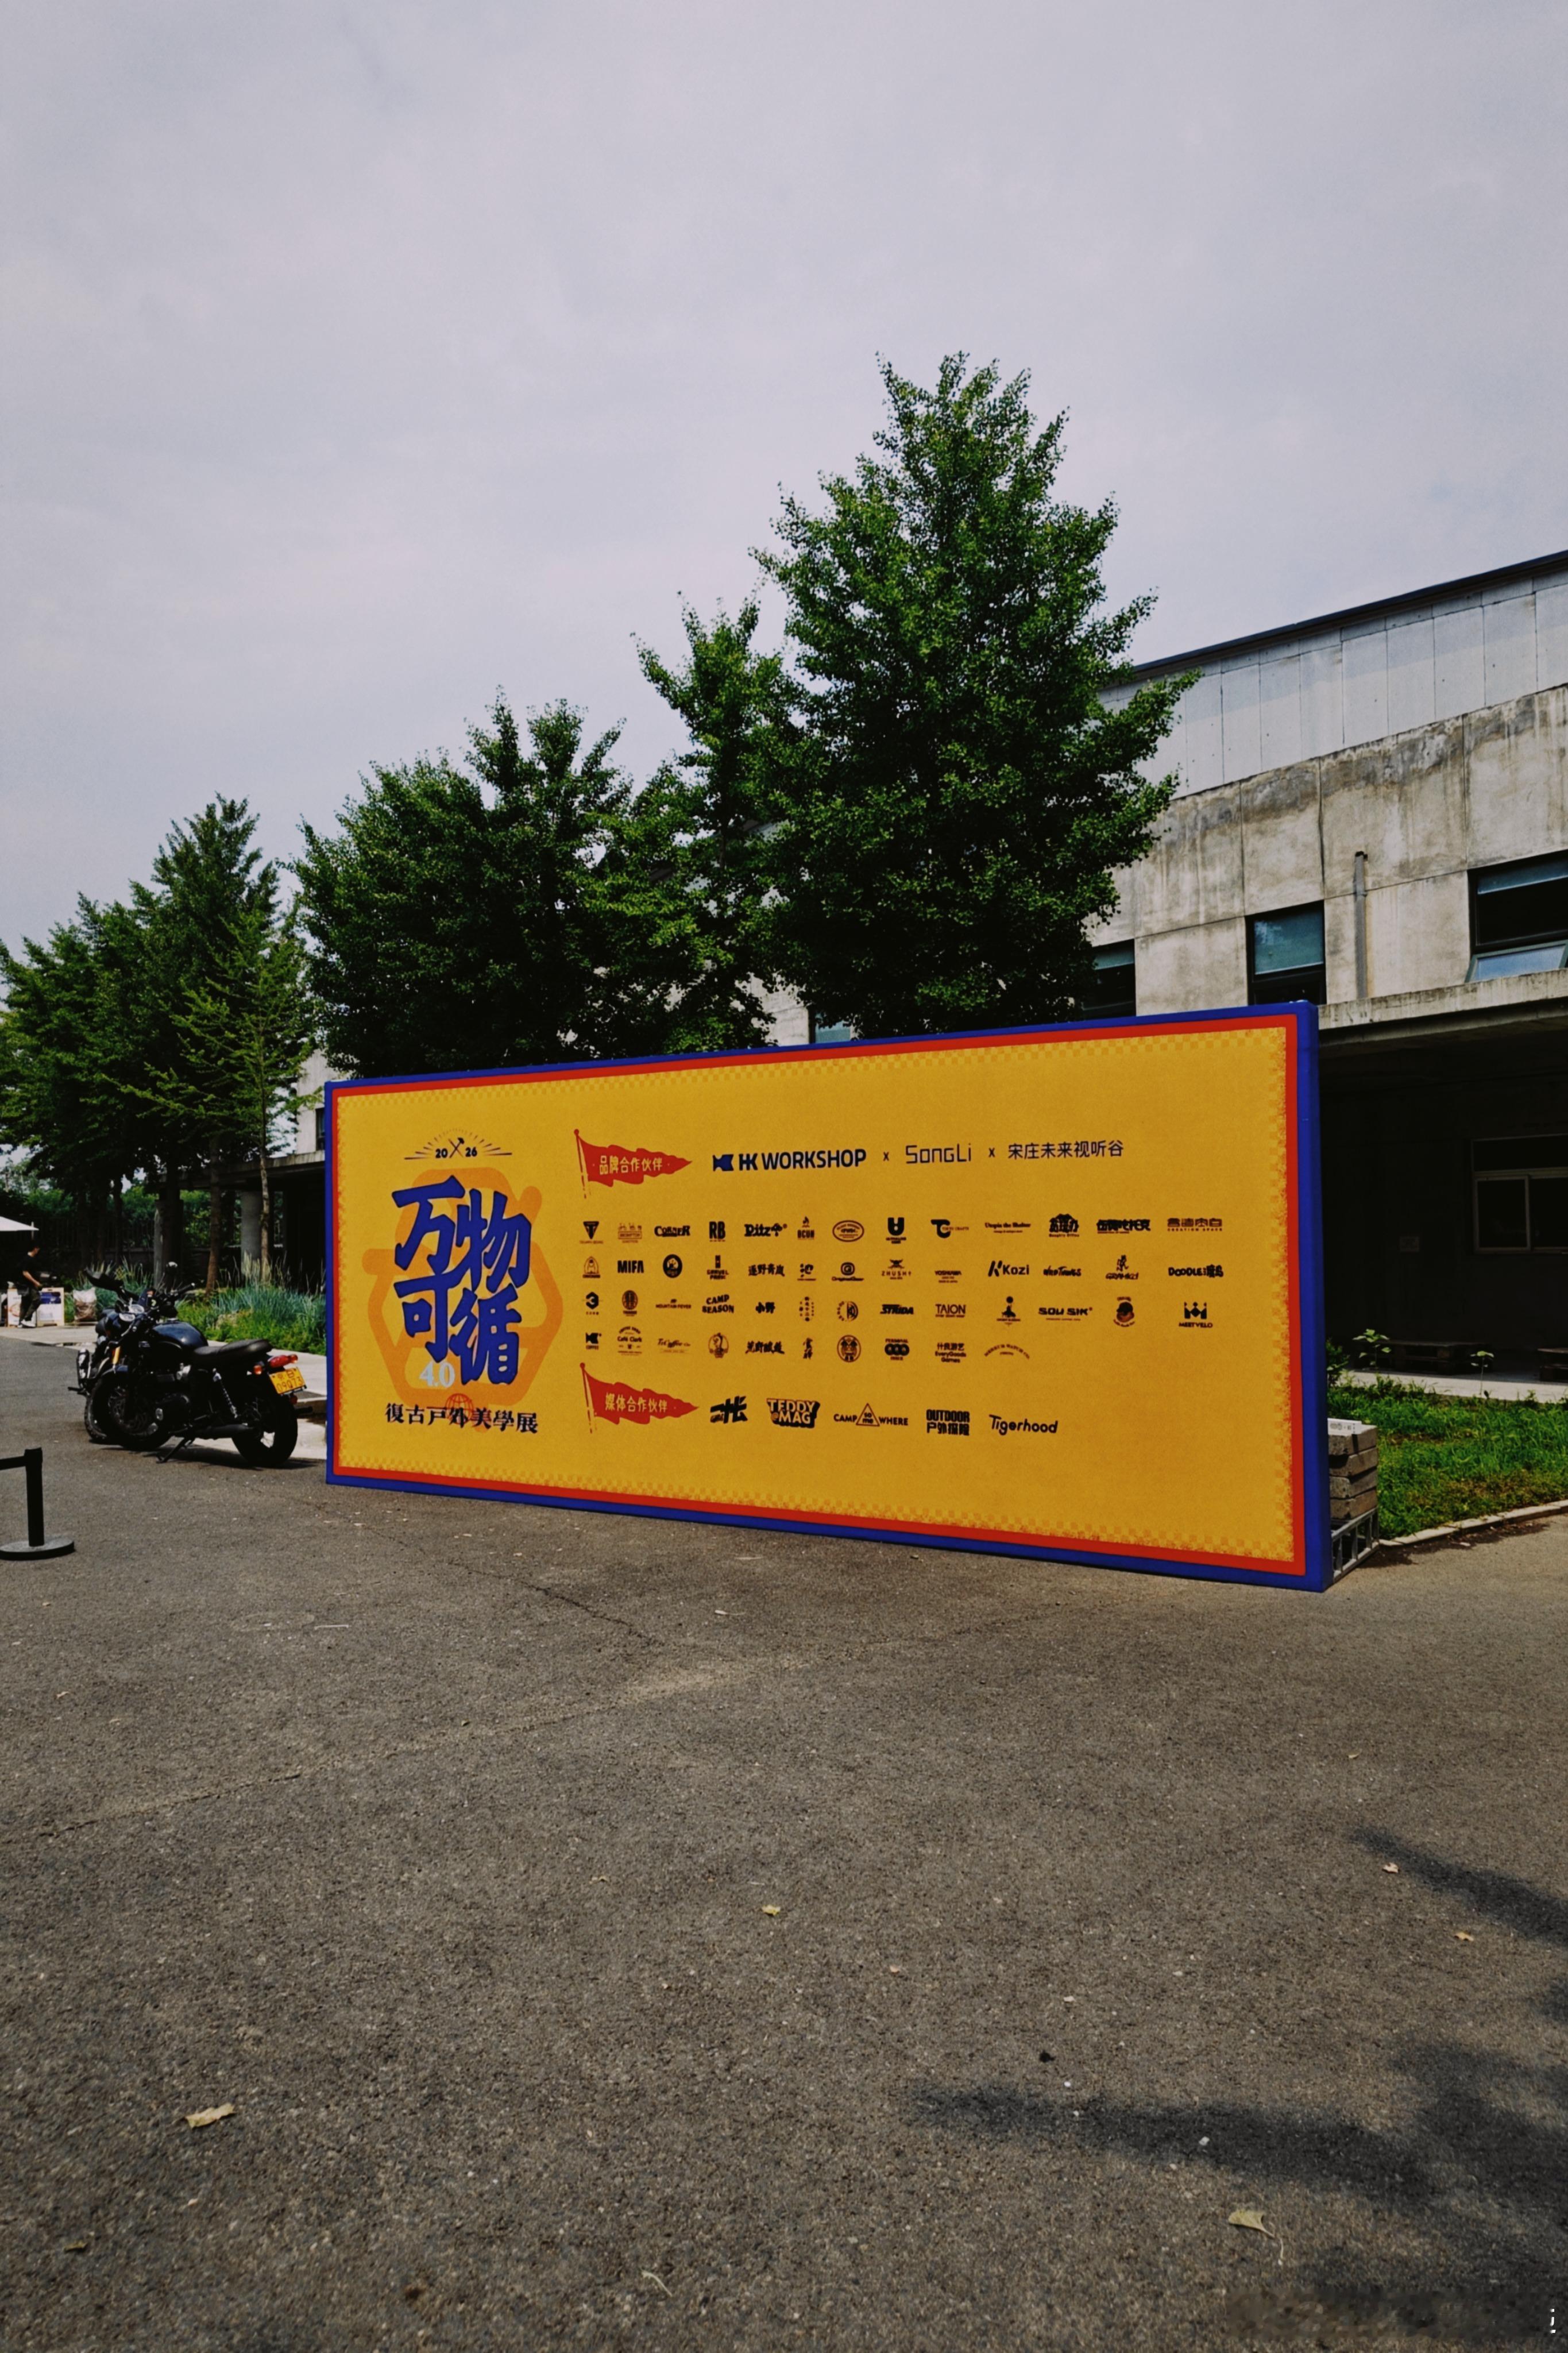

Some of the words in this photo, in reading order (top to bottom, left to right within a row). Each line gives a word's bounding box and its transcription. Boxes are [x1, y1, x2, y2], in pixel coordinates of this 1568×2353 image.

[435, 1149, 448, 1158] 20
[465, 1148, 477, 1157] 26
[761, 1149, 866, 1170] WORKSHOP
[1008, 1140, 1123, 1159] 宋庄未来视听谷
[600, 1155, 662, 1175] 品牌合作伙伴
[617, 1261, 644, 1274] MIFA
[1003, 1264, 1029, 1275] Kozi
[706, 1294, 729, 1305] CAMP
[702, 1305, 734, 1314] SEASON
[935, 1303, 966, 1314] TAION
[419, 1361, 455, 1388] 4.0
[605, 1392, 667, 1412] 媒体合作伙伴
[767, 1399, 816, 1413] TEDDY
[778, 1411, 811, 1424] MAG
[833, 1414, 858, 1422] CAMP
[879, 1417, 909, 1425] WHERE
[926, 1409, 970, 1423] OUTDOOR
[989, 1414, 1058, 1436] Tigerhood
